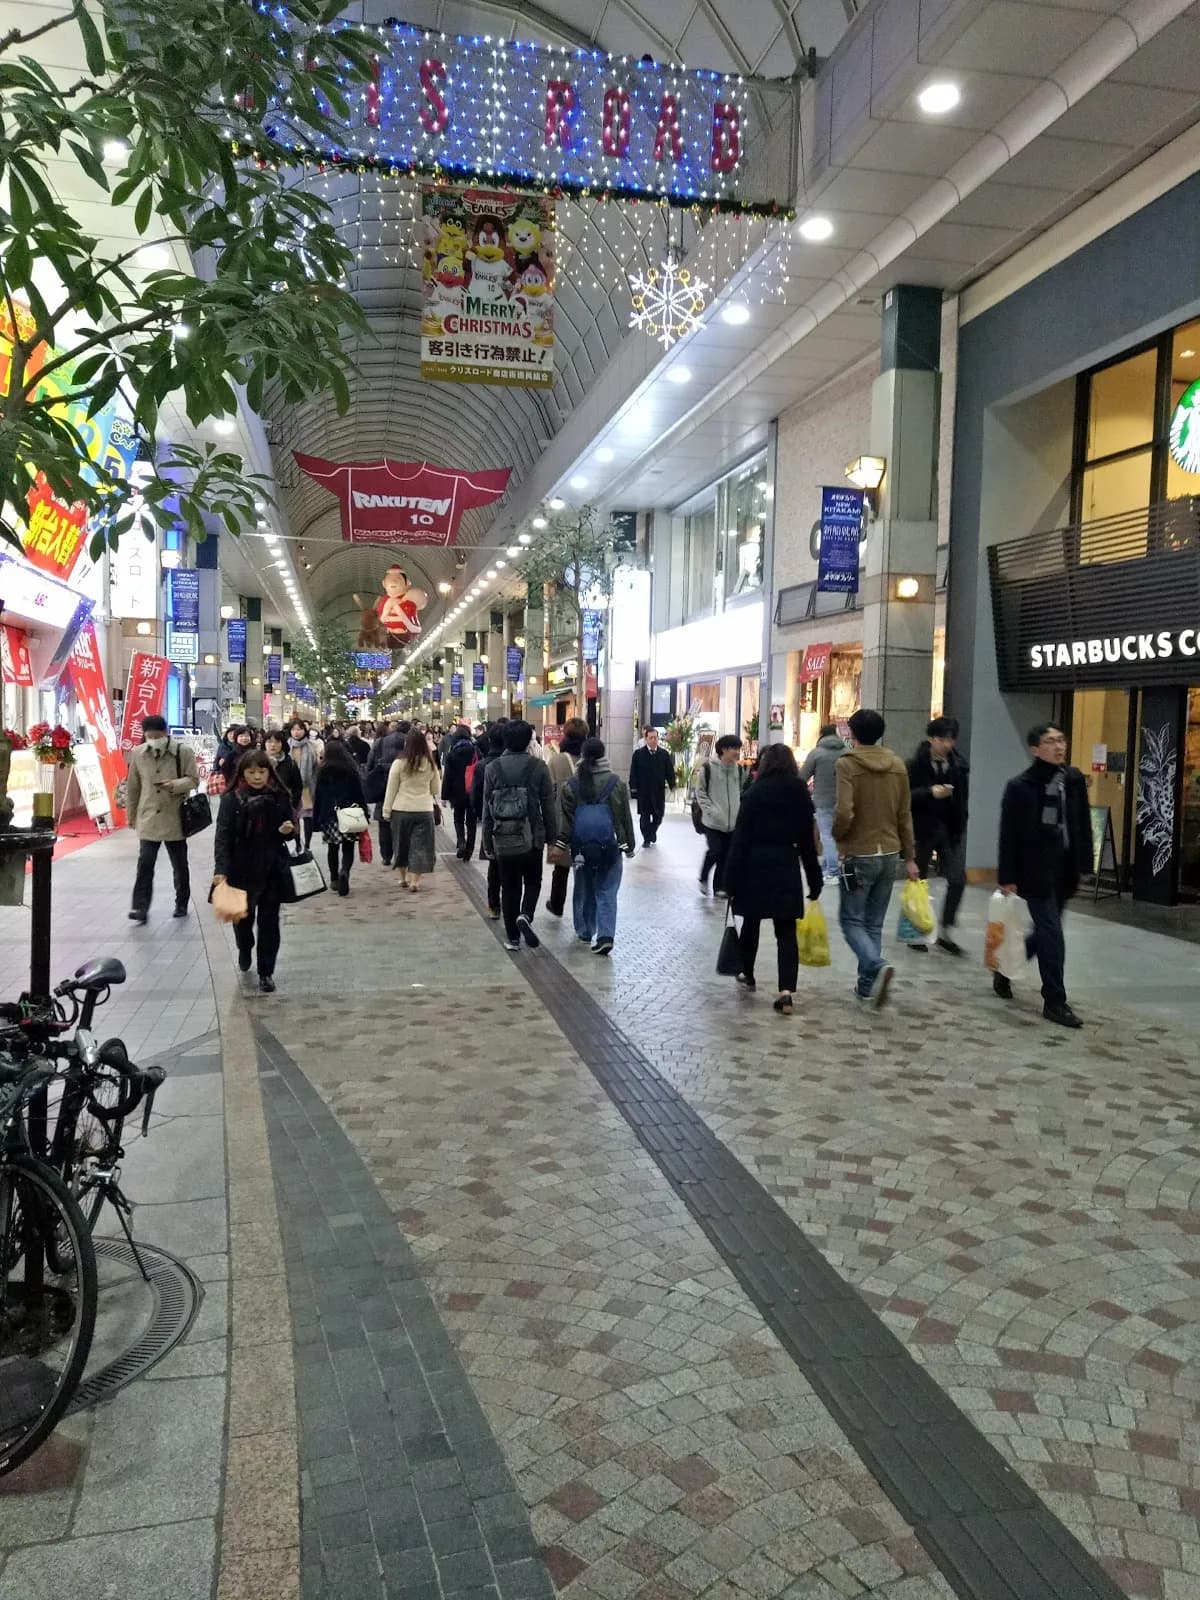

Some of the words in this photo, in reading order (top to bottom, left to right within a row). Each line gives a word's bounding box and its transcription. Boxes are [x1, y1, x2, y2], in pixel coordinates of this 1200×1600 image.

[544, 78, 741, 172] ROAD
[471, 204, 508, 217] EAGLES
[466, 296, 516, 318] MERRY
[444, 314, 532, 338] CHRISTMAS
[428, 340, 546, 364] 客引き行為禁止!
[352, 490, 451, 516] RAKUTEN
[410, 514, 434, 525] 10
[1030, 631, 1173, 668] STARBUCKS
[1179, 629, 1200, 656] C
[806, 655, 826, 671] SALE
